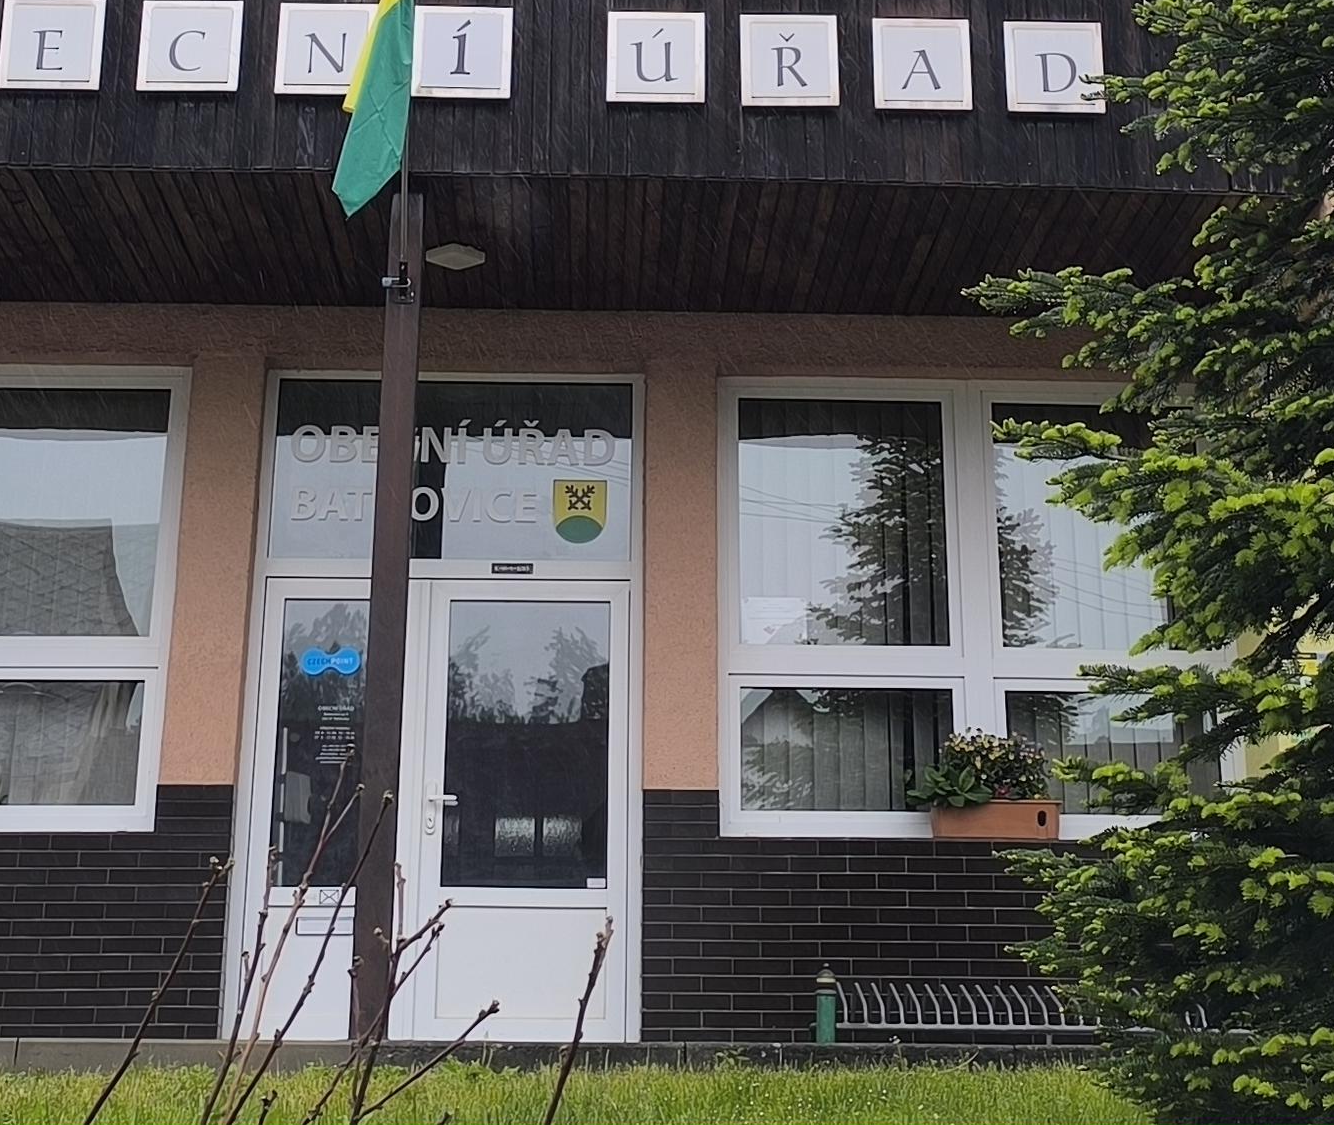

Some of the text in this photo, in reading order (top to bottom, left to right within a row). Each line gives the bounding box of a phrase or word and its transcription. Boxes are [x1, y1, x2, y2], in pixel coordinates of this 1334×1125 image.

[630, 28, 1080, 94] ÚŘAD
[290, 419, 616, 467] OBENÍ ÚŘAD
[291, 485, 538, 524] BATOVICE
